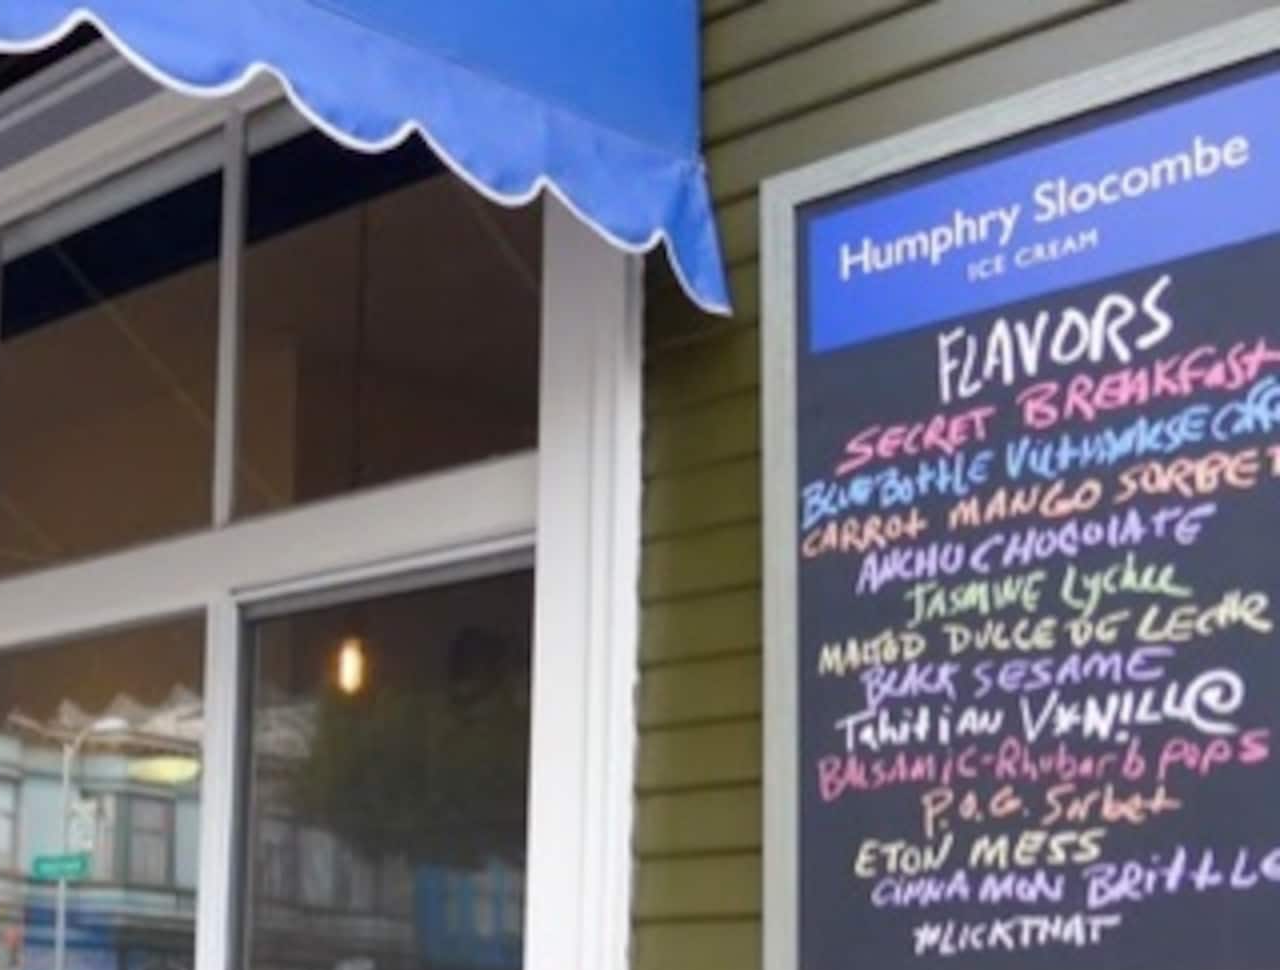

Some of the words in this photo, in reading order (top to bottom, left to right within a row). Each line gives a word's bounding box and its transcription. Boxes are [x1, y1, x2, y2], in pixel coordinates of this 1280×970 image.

[838, 203, 1020, 282] Humphry
[1032, 135, 1250, 224] Slocombe
[967, 255, 1005, 283] ICE
[1015, 228, 1100, 269] CREAM
[936, 273, 1175, 406] FLAVORS
[835, 405, 998, 477] SECRET
[948, 478, 1104, 531] MANGO
[942, 616, 1058, 656] DULCE
[1064, 608, 1132, 648] DE
[972, 645, 1176, 700] SESAME
[852, 830, 955, 879] ETON
[968, 825, 1108, 870] MESS
